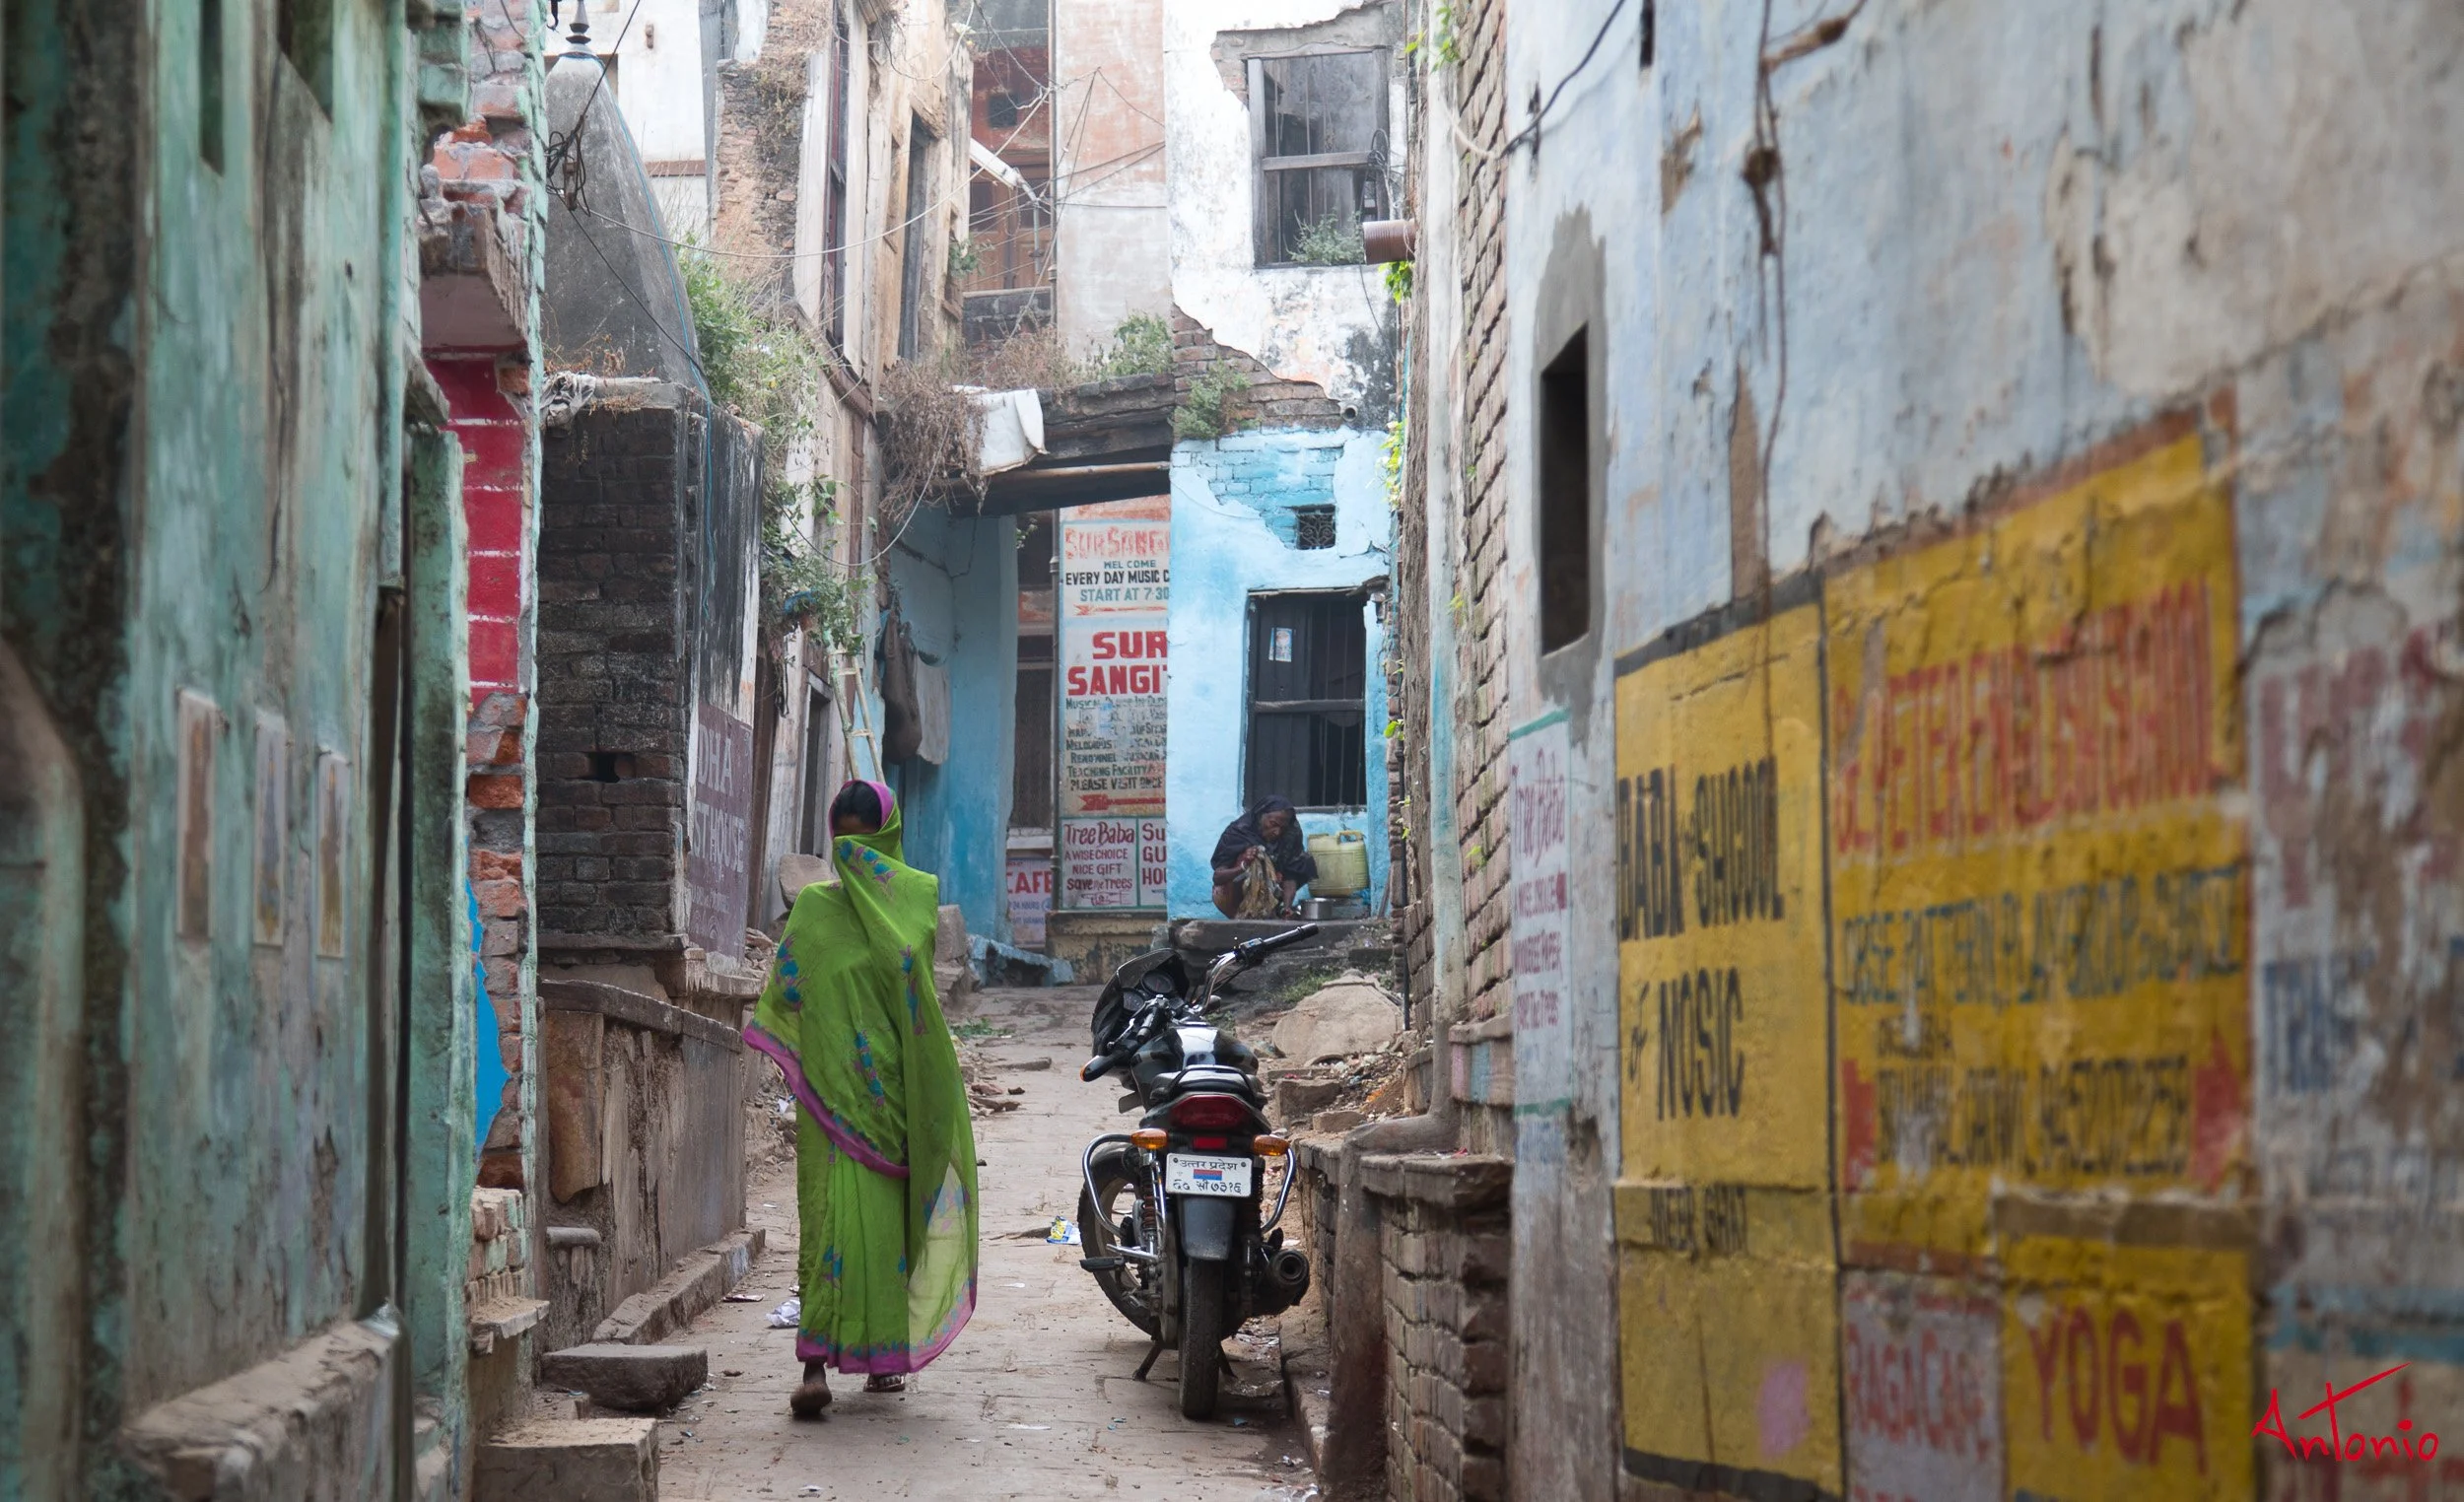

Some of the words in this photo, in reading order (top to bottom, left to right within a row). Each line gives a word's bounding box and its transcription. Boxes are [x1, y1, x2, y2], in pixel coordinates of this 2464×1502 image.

[1065, 572, 1100, 585] EVERY
[1104, 571, 1125, 584] DAY
[1128, 570, 1159, 583] MUSIC
[1080, 588, 1121, 602] START
[1124, 588, 1139, 601] AT
[1092, 631, 1167, 659] SUR
[1067, 665, 1167, 696] SANGI
[1070, 778, 1108, 791] PLEASE
[1111, 777, 1137, 789] VISIT
[1064, 824, 1096, 845] Tree
[1097, 821, 1135, 846] Baba
[1065, 850, 1071, 861] A
[1072, 850, 1095, 860] WISE
[1095, 849, 1129, 859] CHOICE
[1142, 847, 1167, 863] GU
[1072, 864, 1094, 875] NICE
[1097, 863, 1123, 875] GIFT
[1180, 1159, 1207, 1168] उत्तर
[1209, 1158, 1238, 1171] प्रदेश
[2025, 1298, 2210, 1476] YOGA
